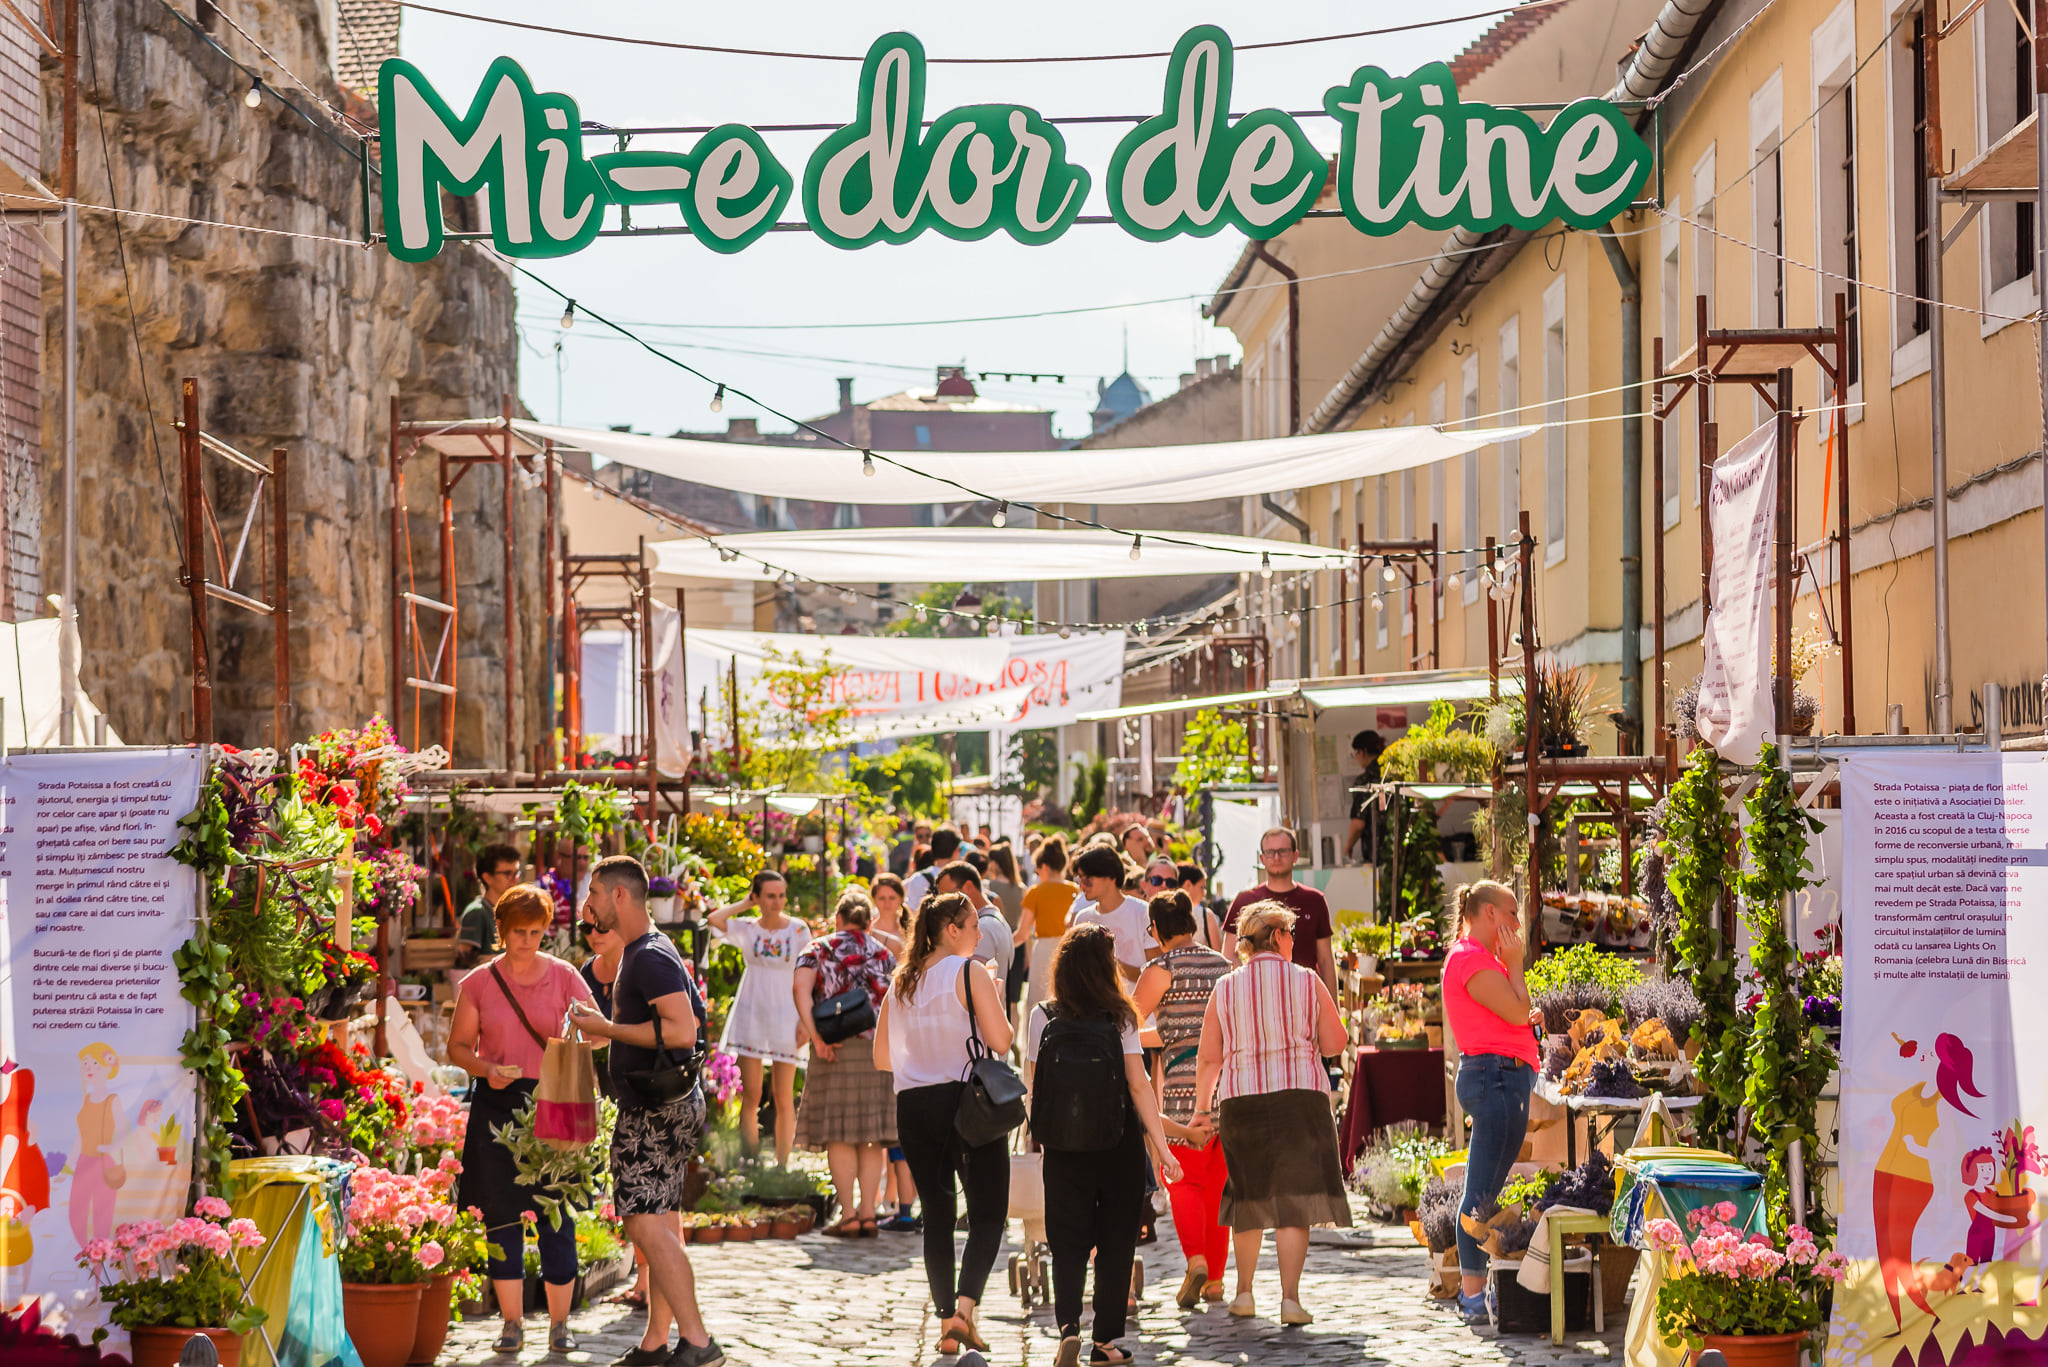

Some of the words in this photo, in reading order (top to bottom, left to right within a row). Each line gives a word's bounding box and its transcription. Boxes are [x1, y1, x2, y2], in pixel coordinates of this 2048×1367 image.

[390, 70, 783, 253] Mi-e
[816, 46, 1081, 242] dor
[1119, 38, 1316, 232] de
[1336, 80, 1641, 226] tine
[38, 781, 66, 790] Strada
[67, 781, 104, 790] Potaissa
[113, 780, 130, 789] fost
[1873, 782, 1902, 791] Strada
[1904, 783, 1940, 792] Potaissa
[1948, 783, 1971, 794] piața
[1972, 783, 1984, 792] de
[1986, 783, 2004, 792] flori
[2006, 783, 2028, 791] altfel
[75, 795, 109, 806] energia
[120, 794, 149, 805] timpul
[150, 793, 172, 802] tutu-
[1874, 798, 1892, 806] este
[1903, 797, 1940, 807] inițiativă
[1949, 797, 1992, 807] Asociației
[1994, 797, 2024, 806] Daisler.
[52, 809, 75, 818] celor
[98, 811, 118, 819] apar
[129, 808, 156, 818] (poate
[1874, 811, 1909, 820] Aceasta
[1918, 812, 1936, 820] fost
[1937, 812, 1965, 820] creată
[1967, 812, 1975, 820] la
[1977, 811, 2033, 822] Cluj-Napoca
[61, 826, 72, 835] pe
[1885, 826, 1907, 835] 2016
[1922, 826, 1952, 836] scopul
[1954, 826, 1966, 835] de
[1975, 826, 1997, 834] testa
[1998, 825, 2030, 835] diverse
[72, 838, 96, 847] cafea
[97, 838, 110, 847] ori
[111, 837, 131, 846] bere
[150, 838, 166, 847] pur
[1874, 841, 1902, 849] forme
[1903, 841, 1915, 849] de
[1917, 841, 1969, 849] reconversie
[45, 853, 75, 863] simplu
[127, 852, 139, 861] pe
[1874, 855, 1904, 866] simplu
[1906, 857, 1929, 866] spus,
[1931, 855, 1977, 865] modalități
[1978, 855, 2009, 864] inedite
[2010, 855, 2028, 866] prin
[116, 866, 145, 874] nostru
[1896, 870, 1926, 880] spațiul
[1927, 870, 1954, 878] urban
[1956, 869, 1966, 878] să
[1967, 869, 1997, 878] devină
[35, 883, 65, 892] merge
[76, 880, 105, 891] primul
[1874, 884, 1891, 893] mai
[1893, 884, 1914, 893] mult
[1915, 884, 1941, 893] decât
[1943, 885, 1963, 893] este.
[1965, 883, 1988, 892] Dacă
[56, 895, 82, 904] doilea
[151, 894, 165, 903] cel
[1874, 899, 1913, 907] revedem
[1915, 900, 1927, 909] pe
[1929, 898, 1957, 907] Strada
[1959, 898, 1997, 908] Potaissa,
[1999, 898, 2022, 907] iarna
[68, 910, 88, 918] care
[99, 908, 115, 918] dat
[116, 910, 136, 918] curs
[137, 908, 165, 917] invita-
[1874, 913, 1932, 922] transformăm
[1933, 912, 1965, 922] centrul
[1966, 913, 2003, 923] orașului
[1874, 927, 1911, 936] circuitul
[1912, 927, 1961, 937] instalațiilor
[1962, 927, 1974, 936] de
[1976, 927, 2007, 936] lumină
[1874, 942, 1900, 950] odată
[1915, 942, 1951, 951] lansarea
[1953, 941, 1980, 952] Lights
[1982, 942, 1996, 951] On
[79, 949, 91, 958] de
[92, 949, 111, 958] flori
[121, 949, 133, 957] de
[135, 949, 163, 959] plante
[1874, 956, 1913, 965] Romania
[1915, 955, 1950, 966] (celebra
[1952, 956, 1974, 965] Lună
[1975, 956, 1990, 965] din
[1992, 956, 2027, 966] Biserică
[33, 963, 60, 972] dintre
[61, 963, 80, 972] cele
[81, 963, 98, 972] mai
[100, 963, 131, 972] diverse
[142, 962, 168, 971] bucu-
[1883, 970, 1909, 979] multe
[1910, 970, 1926, 979] alte
[1928, 970, 1965, 981] instalații
[1966, 971, 1979, 979] de
[56, 977, 68, 986] de
[69, 978, 113, 986] revederea
[115, 977, 161, 987] prietenilor
[33, 992, 53, 1001] buni
[54, 993, 85, 1002] pentru
[99, 992, 117, 1000] asta
[126, 991, 138, 1000] de
[140, 991, 158, 1002] fapt
[32, 1007, 67, 1016] puterea
[96, 1006, 132, 1015] Potaissa
[32, 1021, 47, 1030] noi
[49, 1021, 83, 1030] credem
